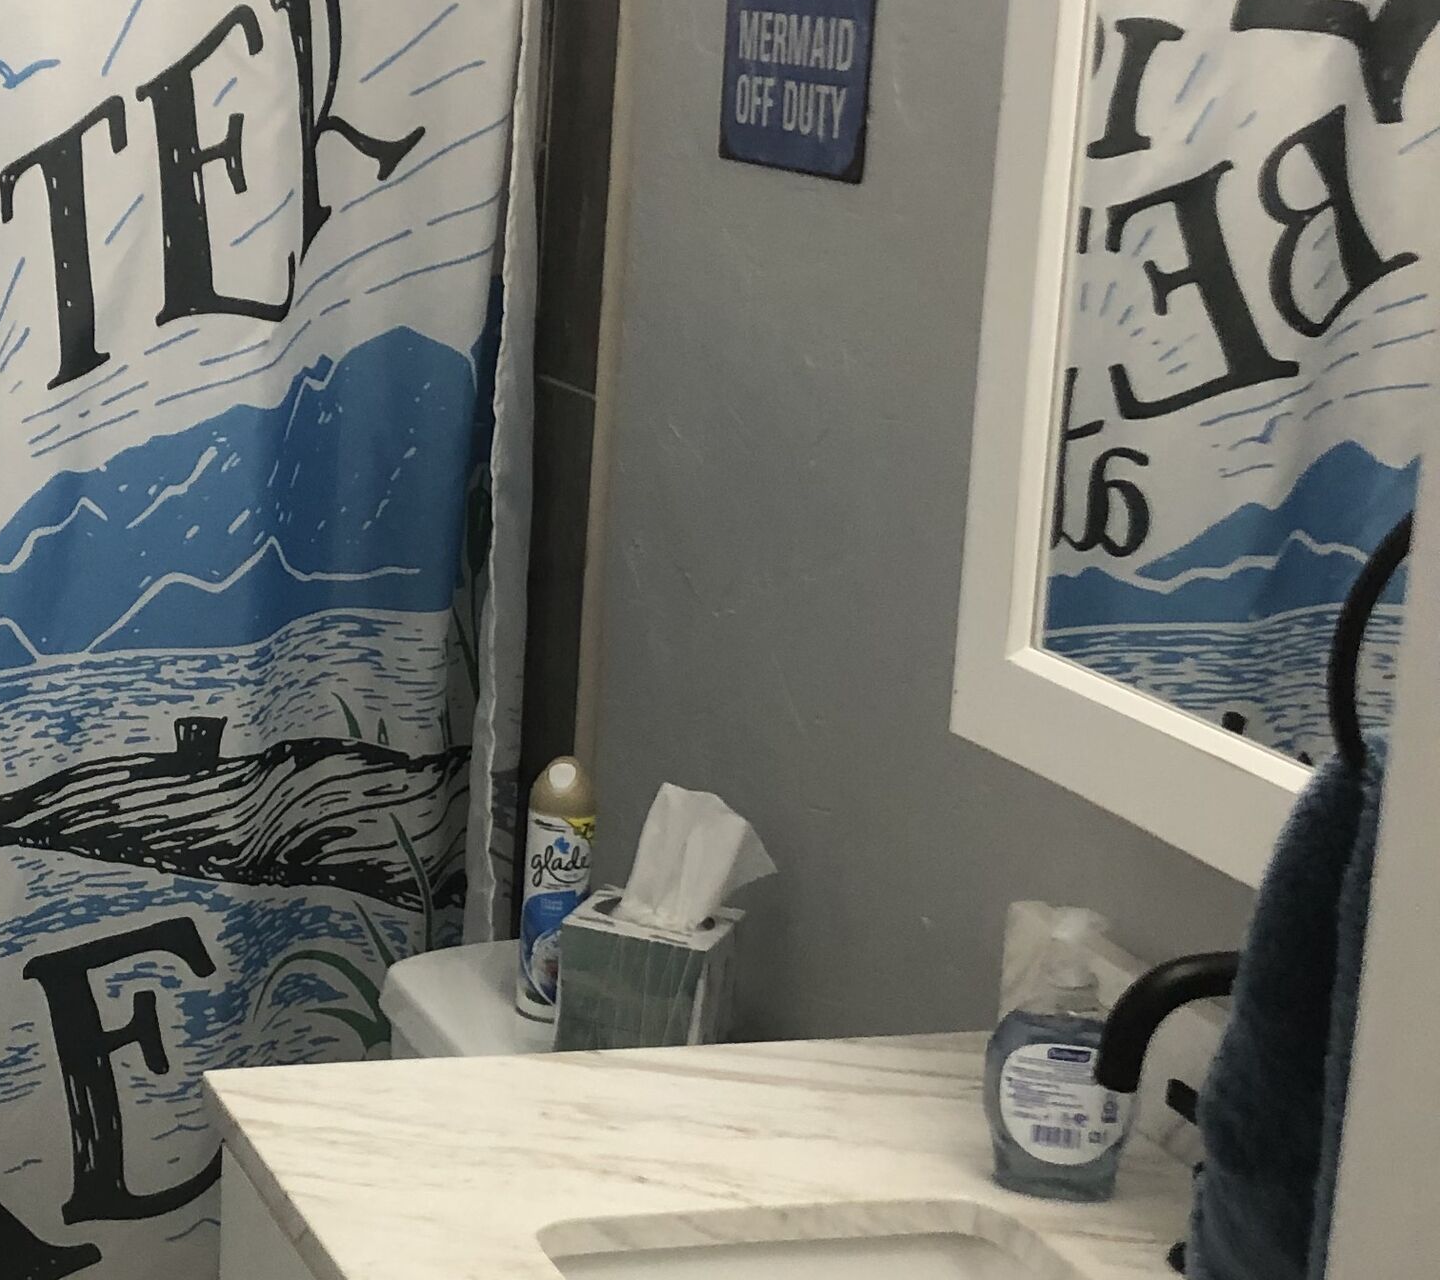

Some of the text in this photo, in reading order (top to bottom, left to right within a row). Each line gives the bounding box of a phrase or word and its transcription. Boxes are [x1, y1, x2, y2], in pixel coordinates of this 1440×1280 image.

[738, 9, 856, 72] MERMAID
[735, 73, 848, 143] OFF DUTY
[530, 844, 591, 888] glade
